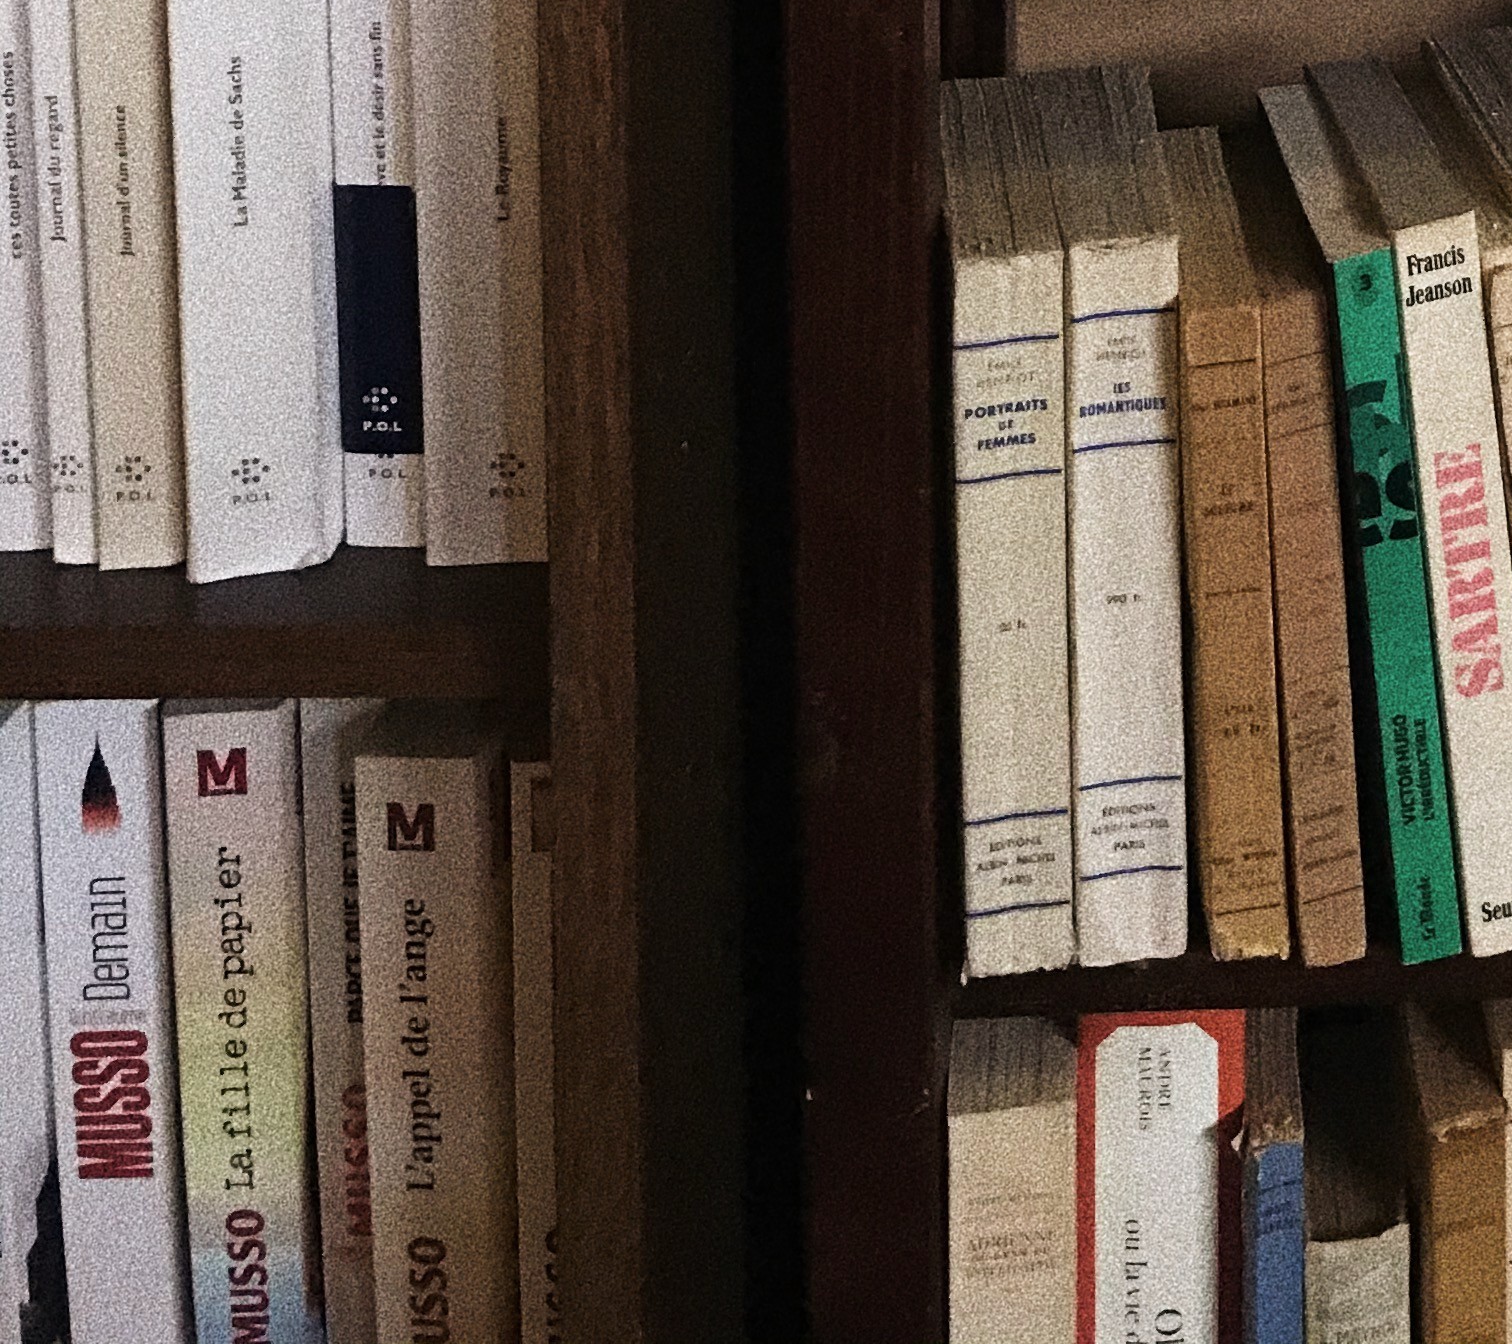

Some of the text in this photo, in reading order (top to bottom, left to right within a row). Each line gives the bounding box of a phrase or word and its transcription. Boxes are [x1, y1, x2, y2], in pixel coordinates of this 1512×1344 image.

[369, 21, 383, 41] fin
[0, 51, 16, 108] choses
[371, 45, 384, 79] sans
[227, 55, 249, 228] La Maladie de Sachs
[43, 95, 68, 243] Journal du regard
[115, 200, 137, 257] Journal
[1406, 243, 1466, 277] Francis
[1405, 273, 1474, 309] Jeanson
[964, 398, 1049, 420] PORTRAITS
[1079, 396, 1167, 418] ROMANTIQUES
[1113, 382, 1131, 394] LES
[363, 420, 402, 432] P.O.L
[977, 433, 1037, 451] FEMMES
[1433, 442, 1505, 700] SARTRE
[83, 875, 130, 1002] Demain
[70, 1029, 154, 1180] MUSSO
[216, 845, 271, 1344] MUSSO La fille de papier
[1137, 1047, 1153, 1131] MAUROIS
[400, 897, 450, 1344] USSO L'appel de l'ange
[1125, 1218, 1139, 1252] ou
